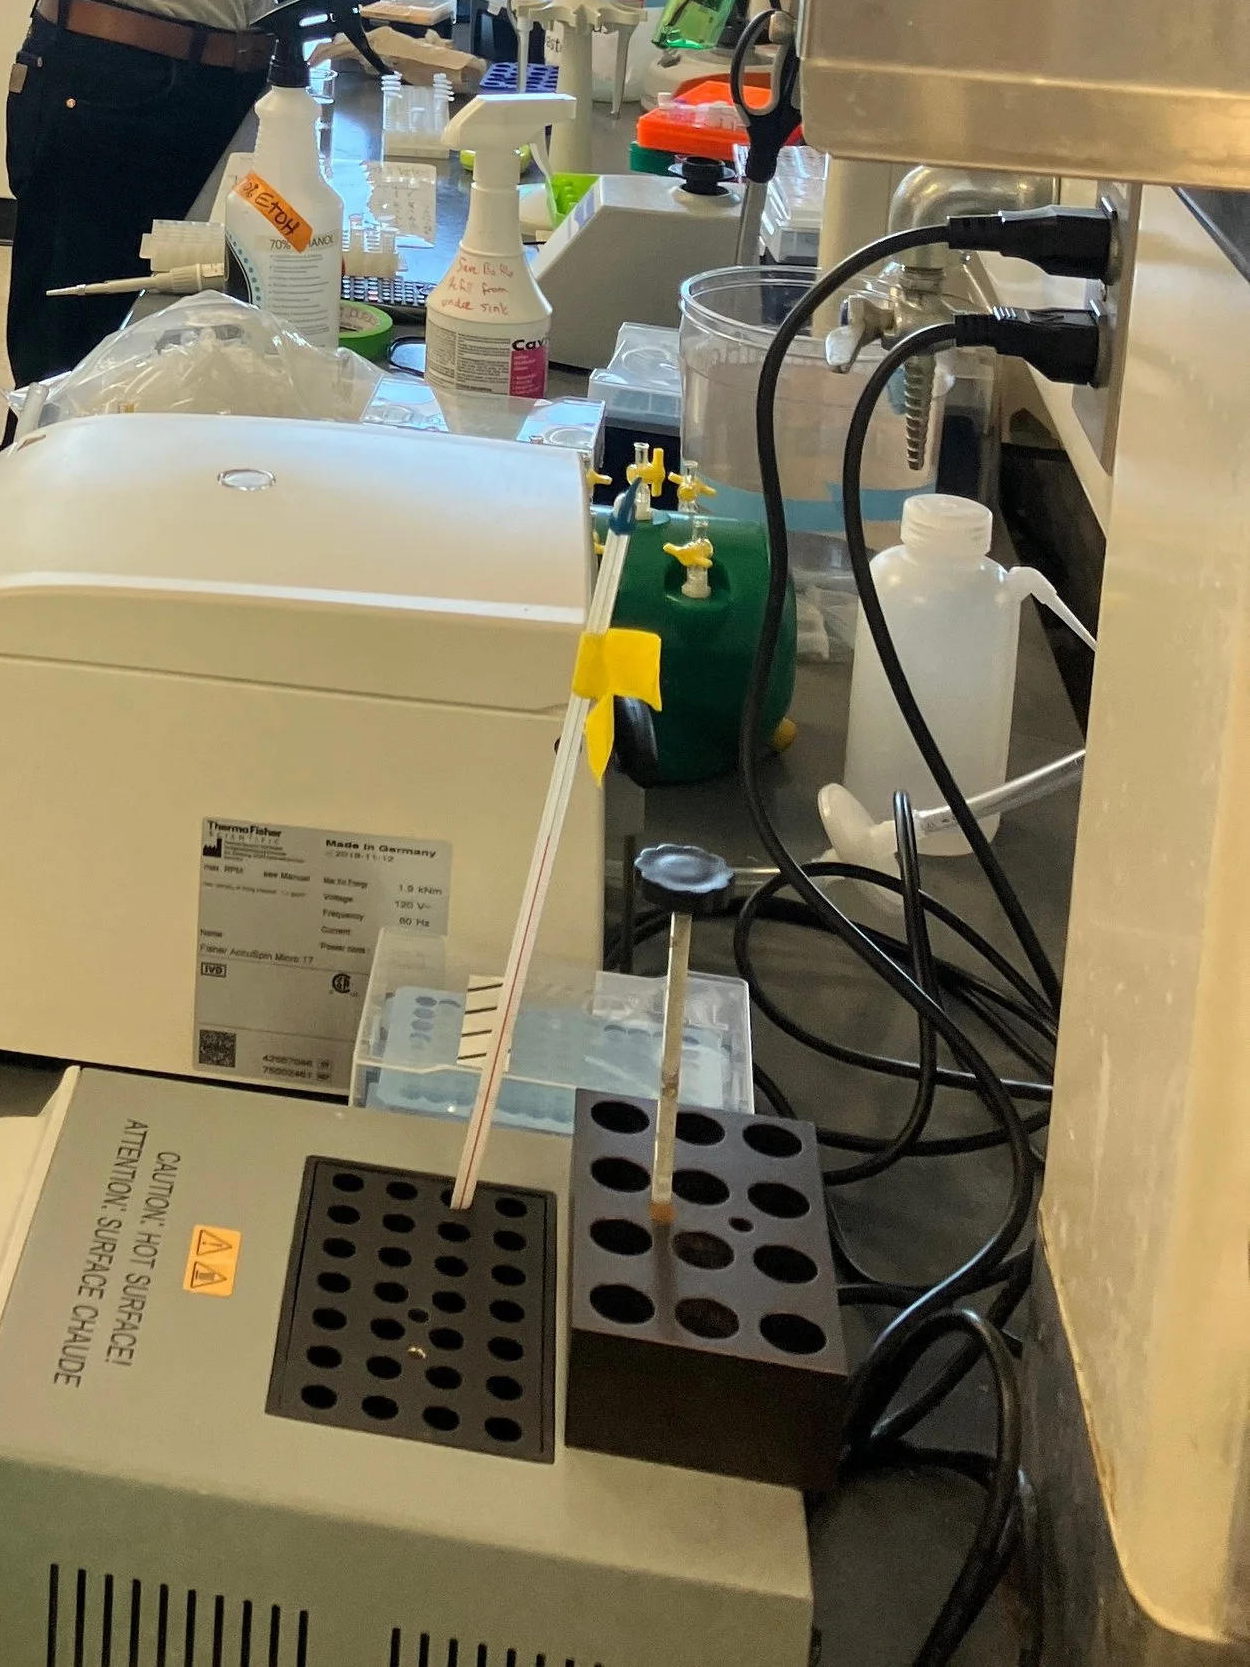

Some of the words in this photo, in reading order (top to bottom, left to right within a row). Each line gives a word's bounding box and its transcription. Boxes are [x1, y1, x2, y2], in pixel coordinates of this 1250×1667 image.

[269, 238, 291, 250] 70%
[326, 839, 359, 849] Made
[379, 844, 437, 859] Germany
[416, 917, 430, 927] Hz
[275, 953, 300, 964] Micro
[302, 955, 314, 965] 17
[204, 965, 224, 974] IVD
[77, 1216, 122, 1300] SURFACE
[130, 1232, 162, 1270] HOT
[105, 1273, 151, 1367] SURFACE!
[53, 1304, 99, 1388] CHAUDE
